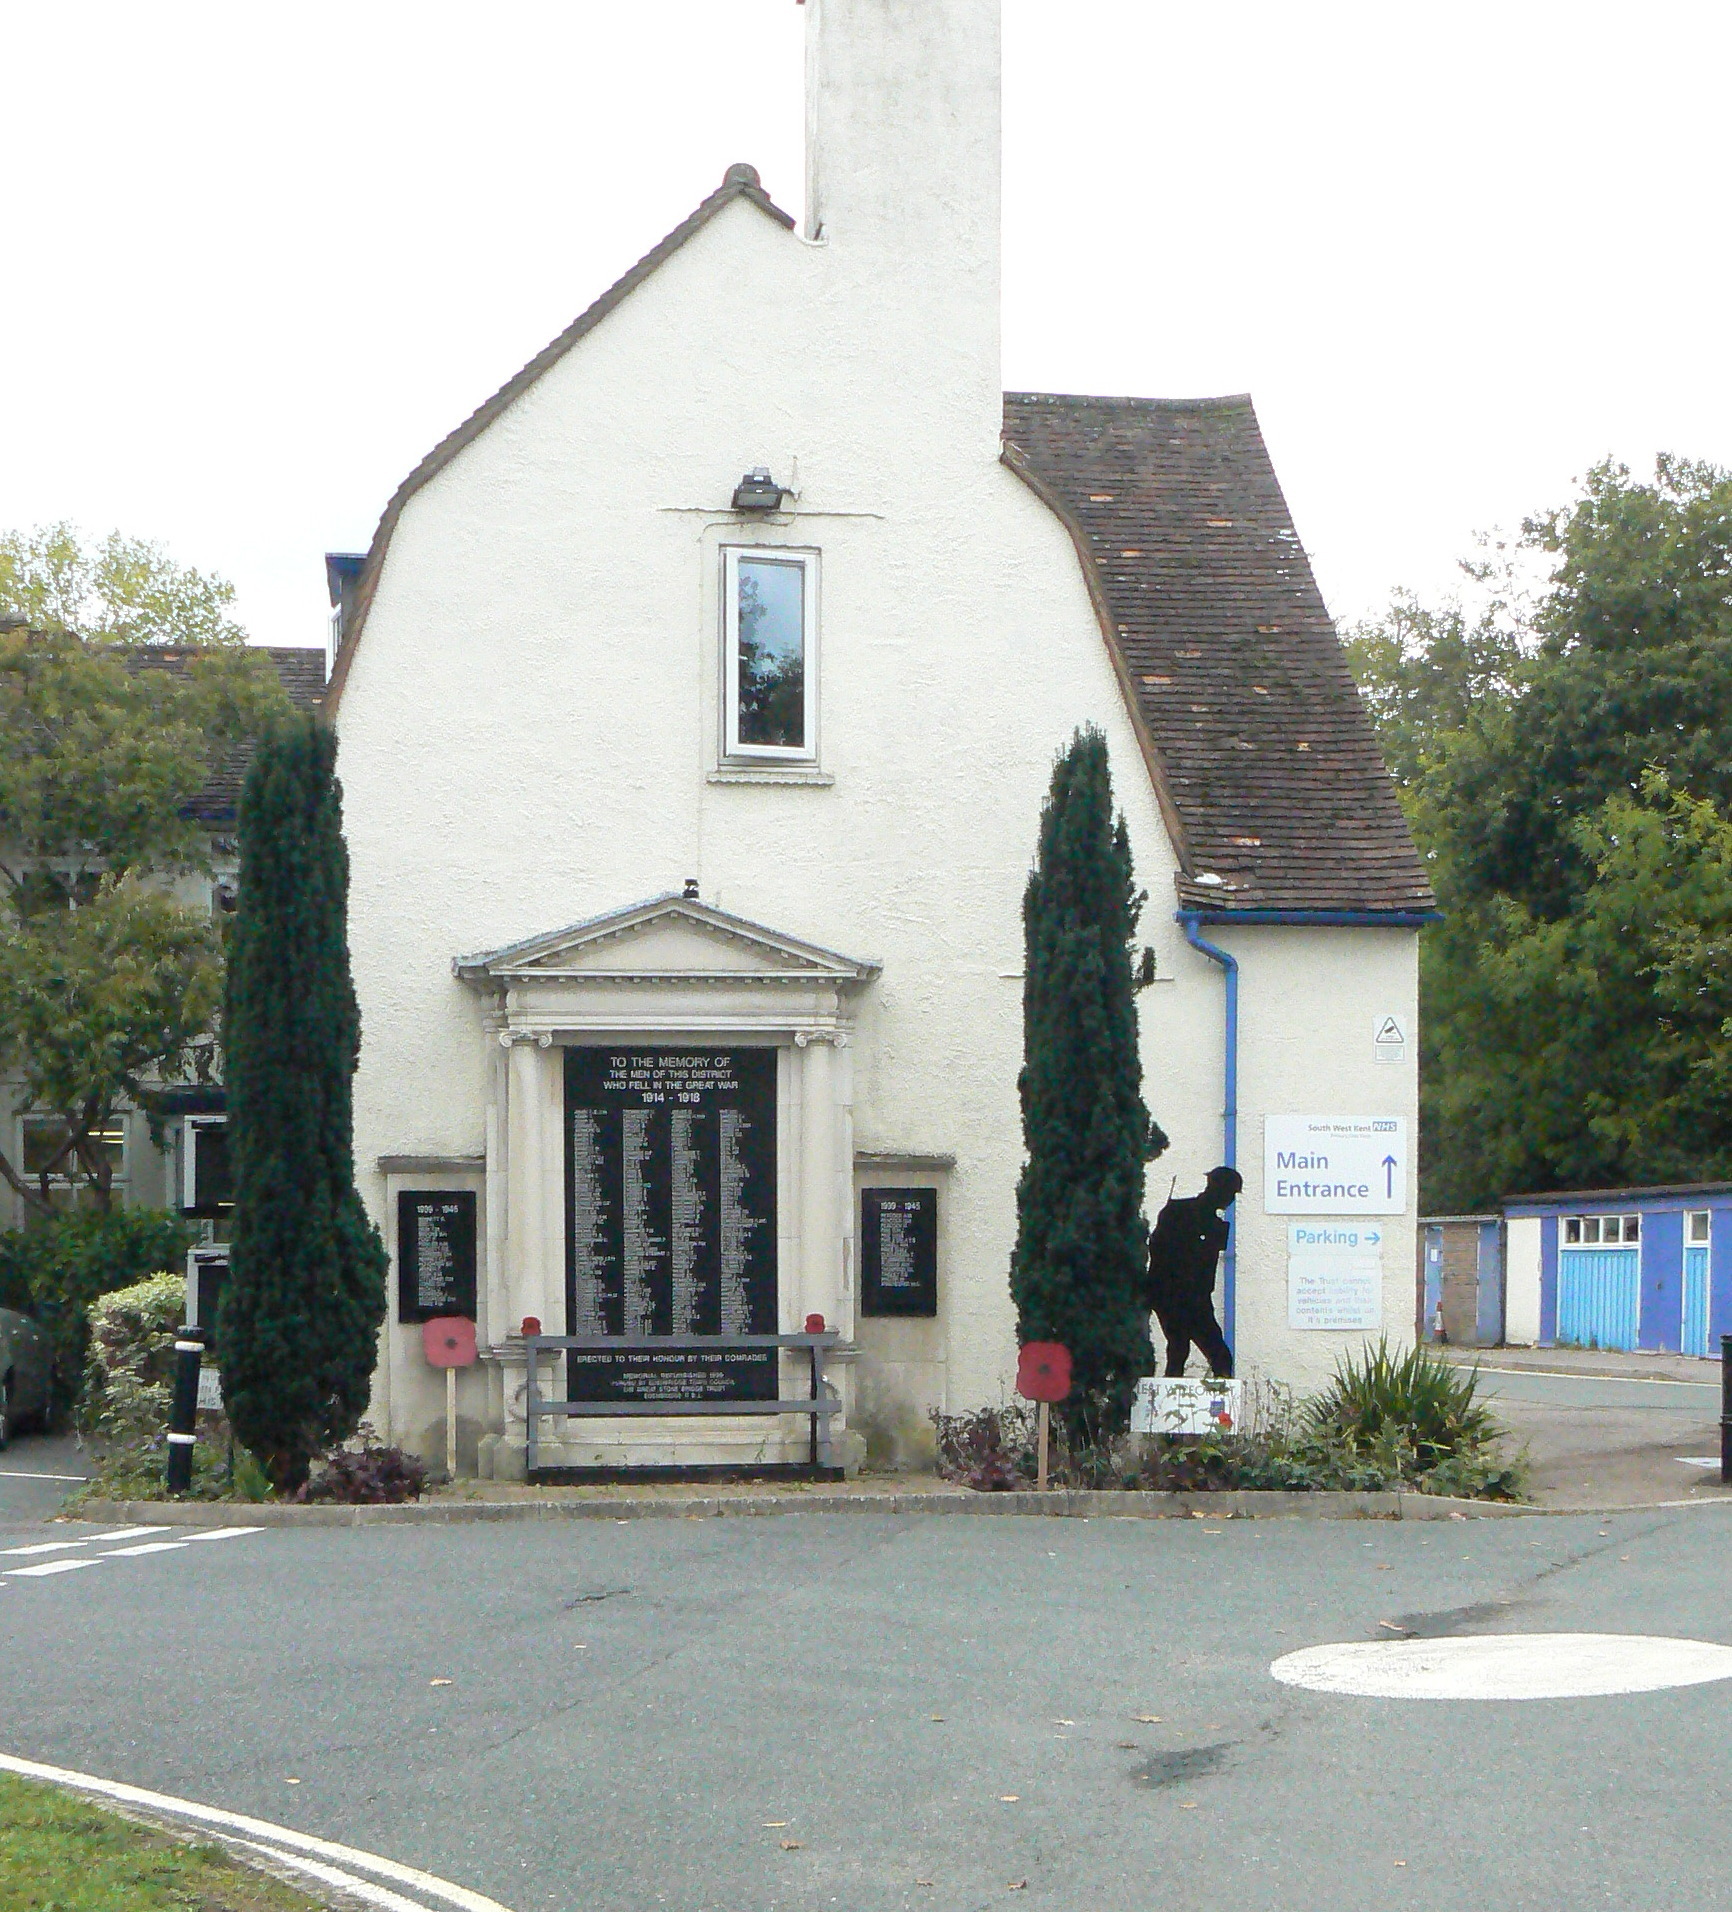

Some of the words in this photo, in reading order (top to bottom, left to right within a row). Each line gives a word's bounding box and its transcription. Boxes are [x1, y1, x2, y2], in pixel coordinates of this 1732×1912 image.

[610, 1056, 626, 1068] TO
[631, 1056, 654, 1068] THE
[658, 1056, 710, 1068] MEMORY
[714, 1056, 731, 1068] OF
[610, 1070, 627, 1078] THE
[630, 1070, 650, 1078] MEN
[652, 1070, 666, 1078] OF
[668, 1070, 688, 1078] THIS
[691, 1070, 732, 1078] DISTRICT
[603, 1081, 626, 1090] WHO
[628, 1081, 651, 1090] FELL
[652, 1081, 663, 1090] IN
[665, 1081, 683, 1090] THE
[686, 1081, 714, 1090] GREAT
[717, 1081, 739, 1090] WAR
[642, 1092, 664, 1103] 1914
[678, 1092, 700, 1103] 1918
[1308, 1124, 1331, 1132] South
[1332, 1124, 1352, 1132] West
[1354, 1124, 1371, 1132] Kent
[1373, 1121, 1397, 1132] NHS
[1277, 1151, 1328, 1169] Main
[1277, 1180, 1369, 1198] Entrance
[1296, 1230, 1358, 1247] Parking
[1300, 1277, 1314, 1285] The
[577, 1354, 612, 1363] ERECTED
[615, 1355, 625, 1363] TO
[628, 1355, 649, 1363] THEIR
[652, 1354, 685, 1362] HONOUR
[688, 1354, 697, 1362] BY
[701, 1354, 722, 1362] THEIR
[724, 1354, 767, 1362] COMRADES
